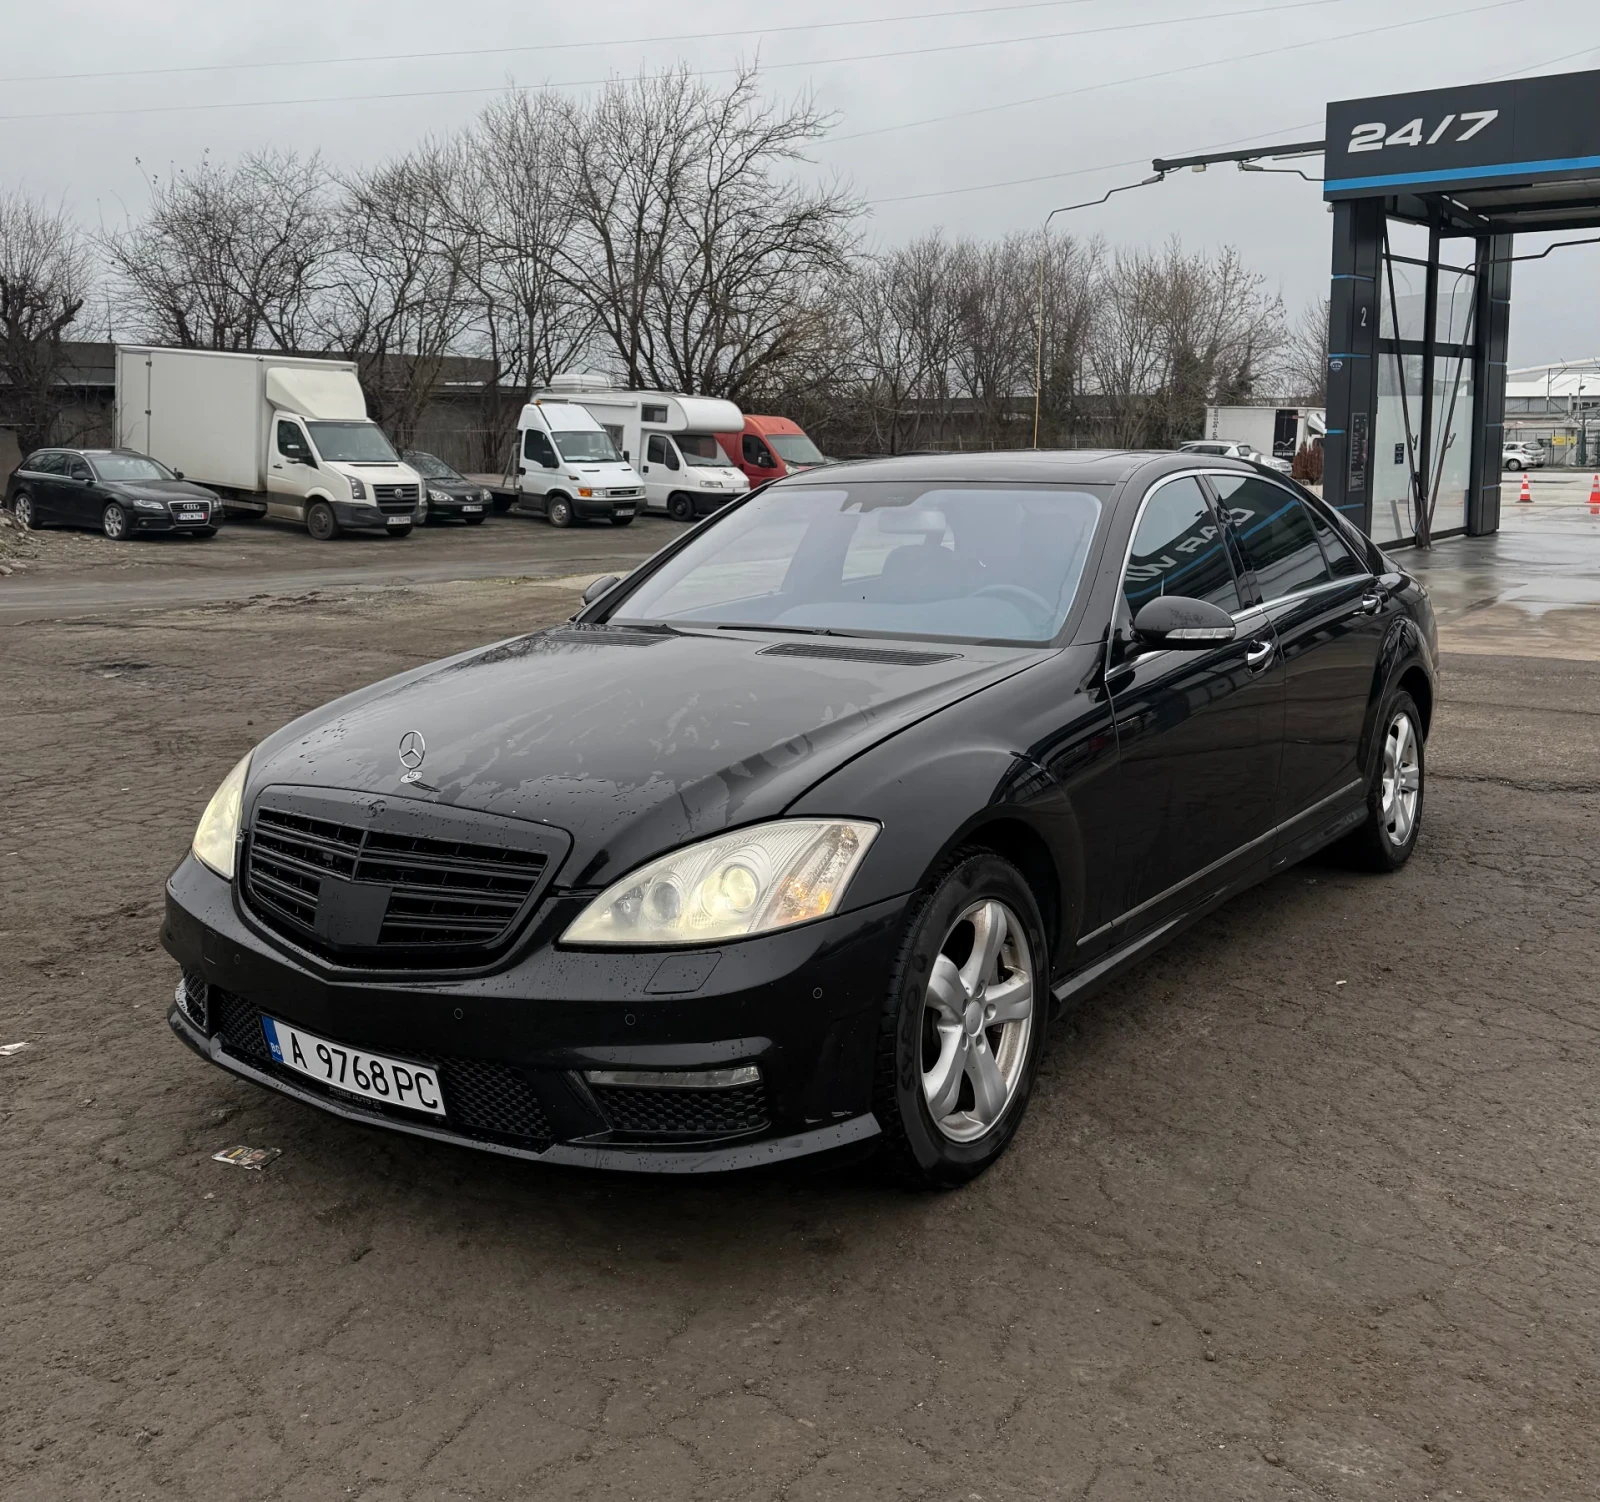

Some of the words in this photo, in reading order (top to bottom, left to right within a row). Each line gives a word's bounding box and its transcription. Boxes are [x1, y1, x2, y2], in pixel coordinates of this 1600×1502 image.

[1348, 109, 1499, 153] 24/7
[1360, 306, 1367, 327] 2
[270, 1042, 282, 1055] BG
[290, 1032, 308, 1069] A
